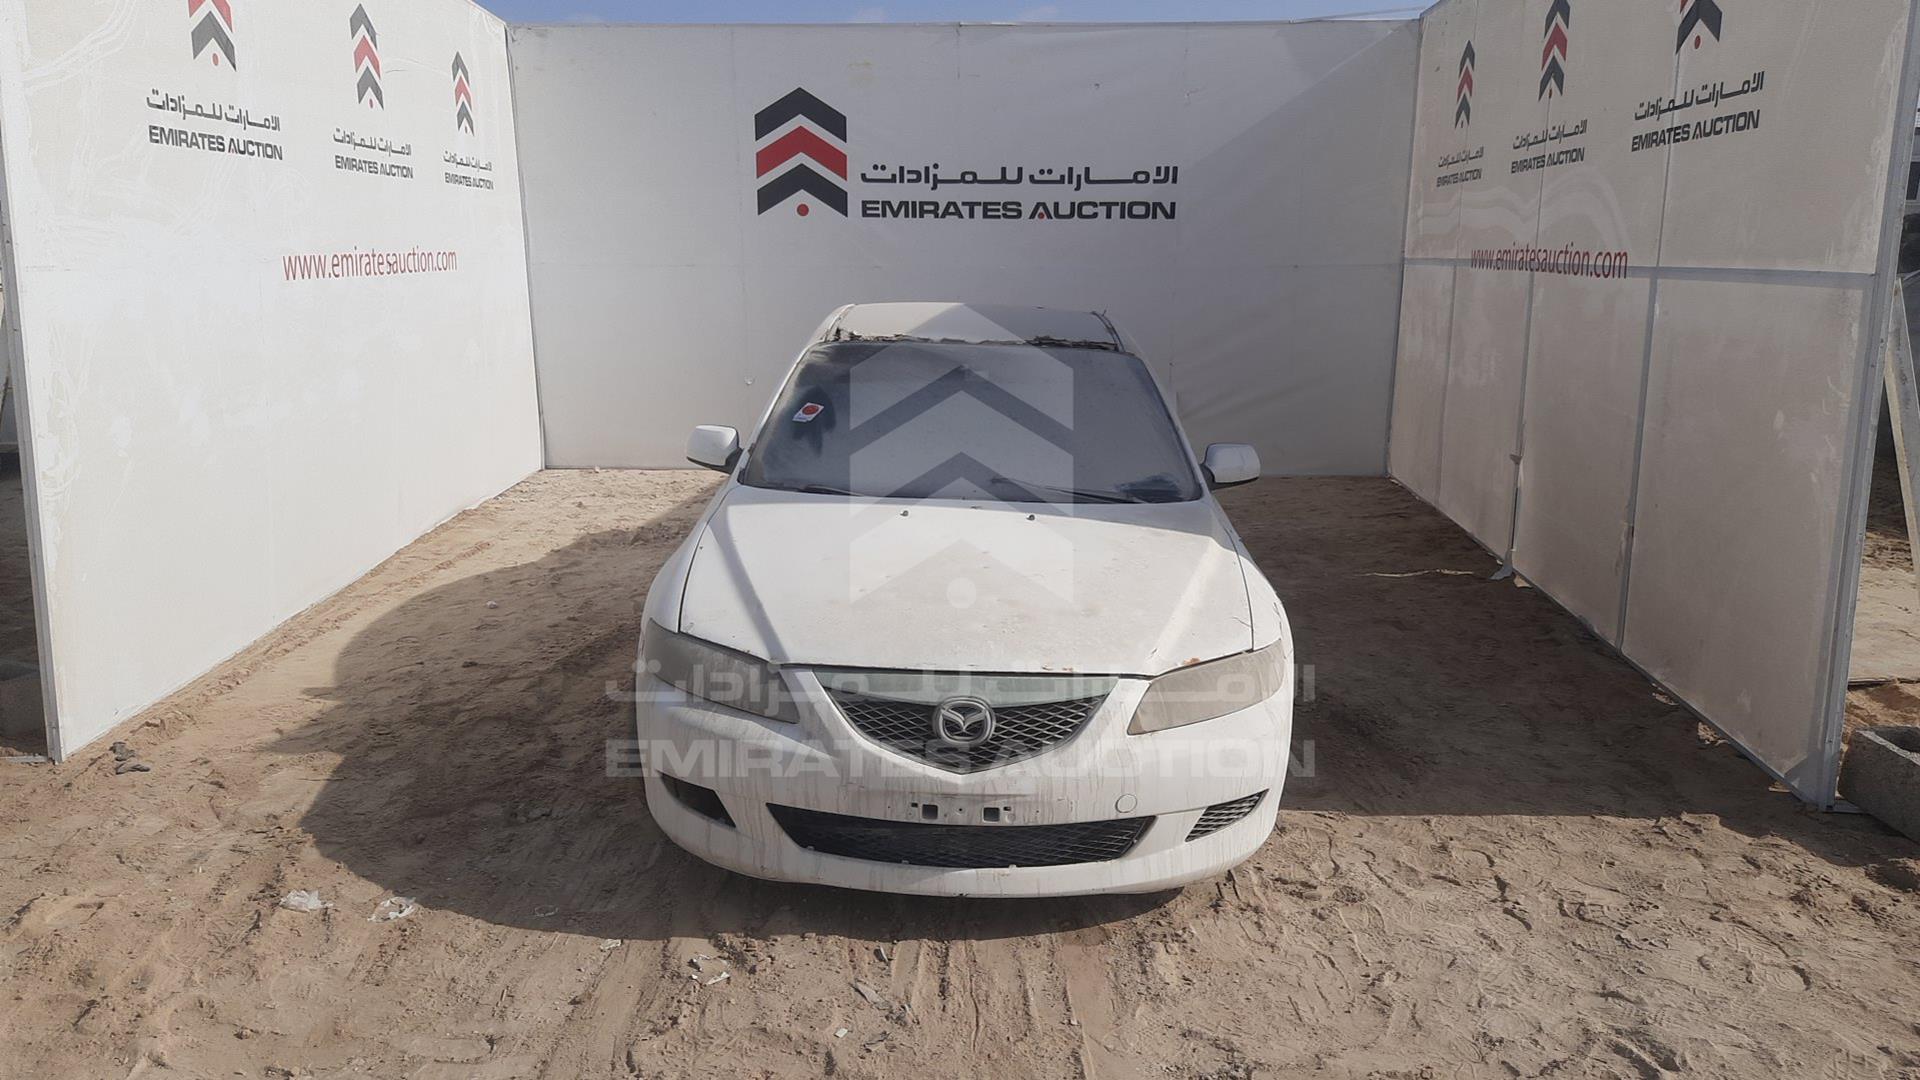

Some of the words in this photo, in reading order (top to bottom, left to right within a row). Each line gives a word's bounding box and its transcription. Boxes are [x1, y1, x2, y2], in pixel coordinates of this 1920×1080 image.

[148, 125, 225, 152] EMIRATES
[228, 138, 282, 160] AUCTION
[1631, 123, 1691, 152] EMIRATES
[1692, 109, 1760, 140] AUCTION
[334, 155, 379, 174] EMIRATES
[380, 163, 414, 179] AUCTION
[1511, 154, 1546, 174] EMIRATES
[1546, 147, 1586, 167] AUCTION
[444, 172, 472, 187] EMIRATES
[472, 177, 494, 190] AUCTION
[860, 163, 1023, 190] للمزادات
[1029, 166, 1178, 191] الامارات
[1436, 173, 1459, 187] EMIRATES
[1459, 168, 1482, 185] AUCTION
[861, 200, 1022, 219] EMIRATES
[1028, 201, 1177, 220] AUCTION
[283, 246, 458, 281] www.emiratesauction.com
[1470, 243, 1628, 279] www.emiratesauction.com
